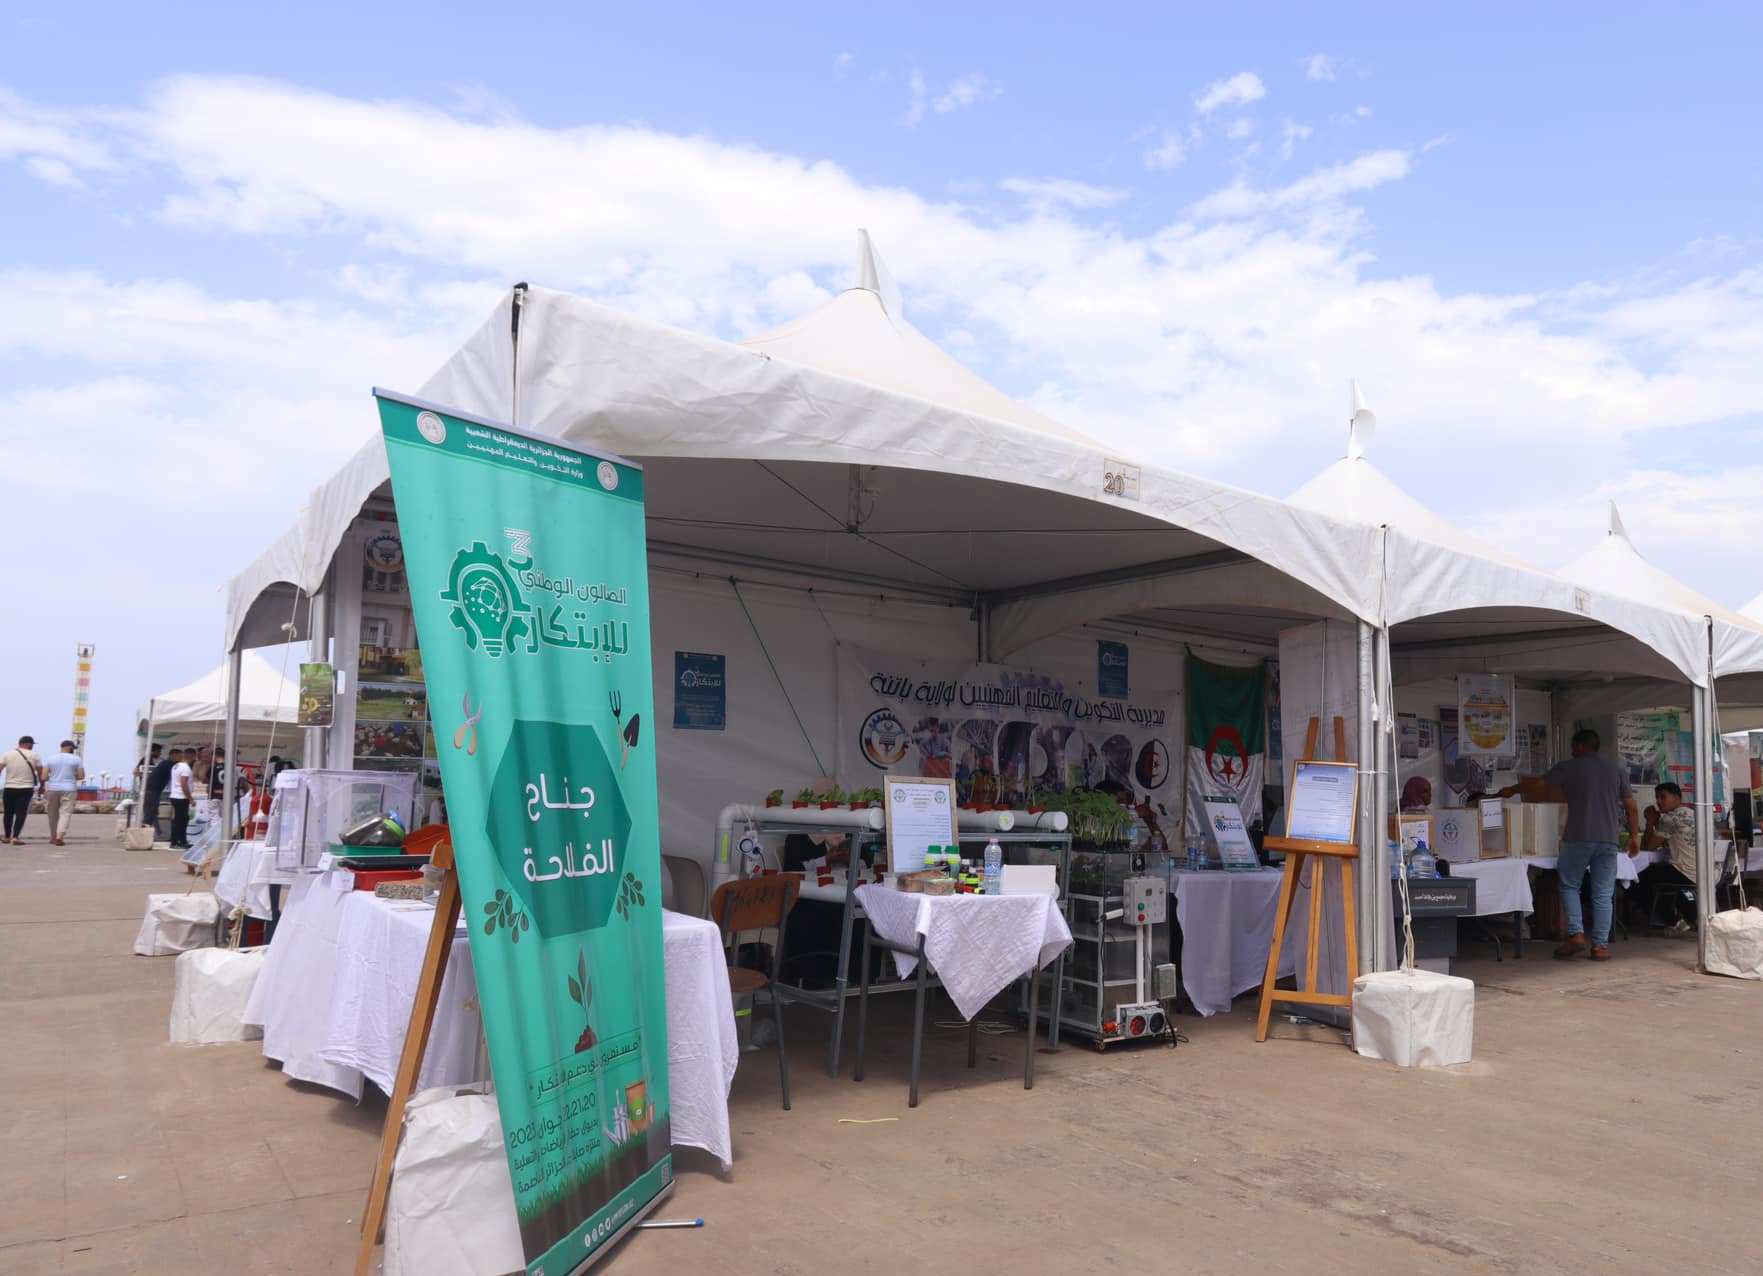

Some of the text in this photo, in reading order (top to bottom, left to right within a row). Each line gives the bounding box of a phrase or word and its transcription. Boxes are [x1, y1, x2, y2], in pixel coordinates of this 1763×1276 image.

[1104, 472, 1125, 496] 20
[519, 569, 627, 605] الصالون الوطني
[870, 672, 912, 702] باتنة
[960, 682, 1020, 708] المهنيين
[1075, 697, 1126, 724] التكوين
[1127, 705, 1166, 728] مديرية
[526, 773, 595, 822] جناح
[523, 839, 615, 882] الفلاحة
